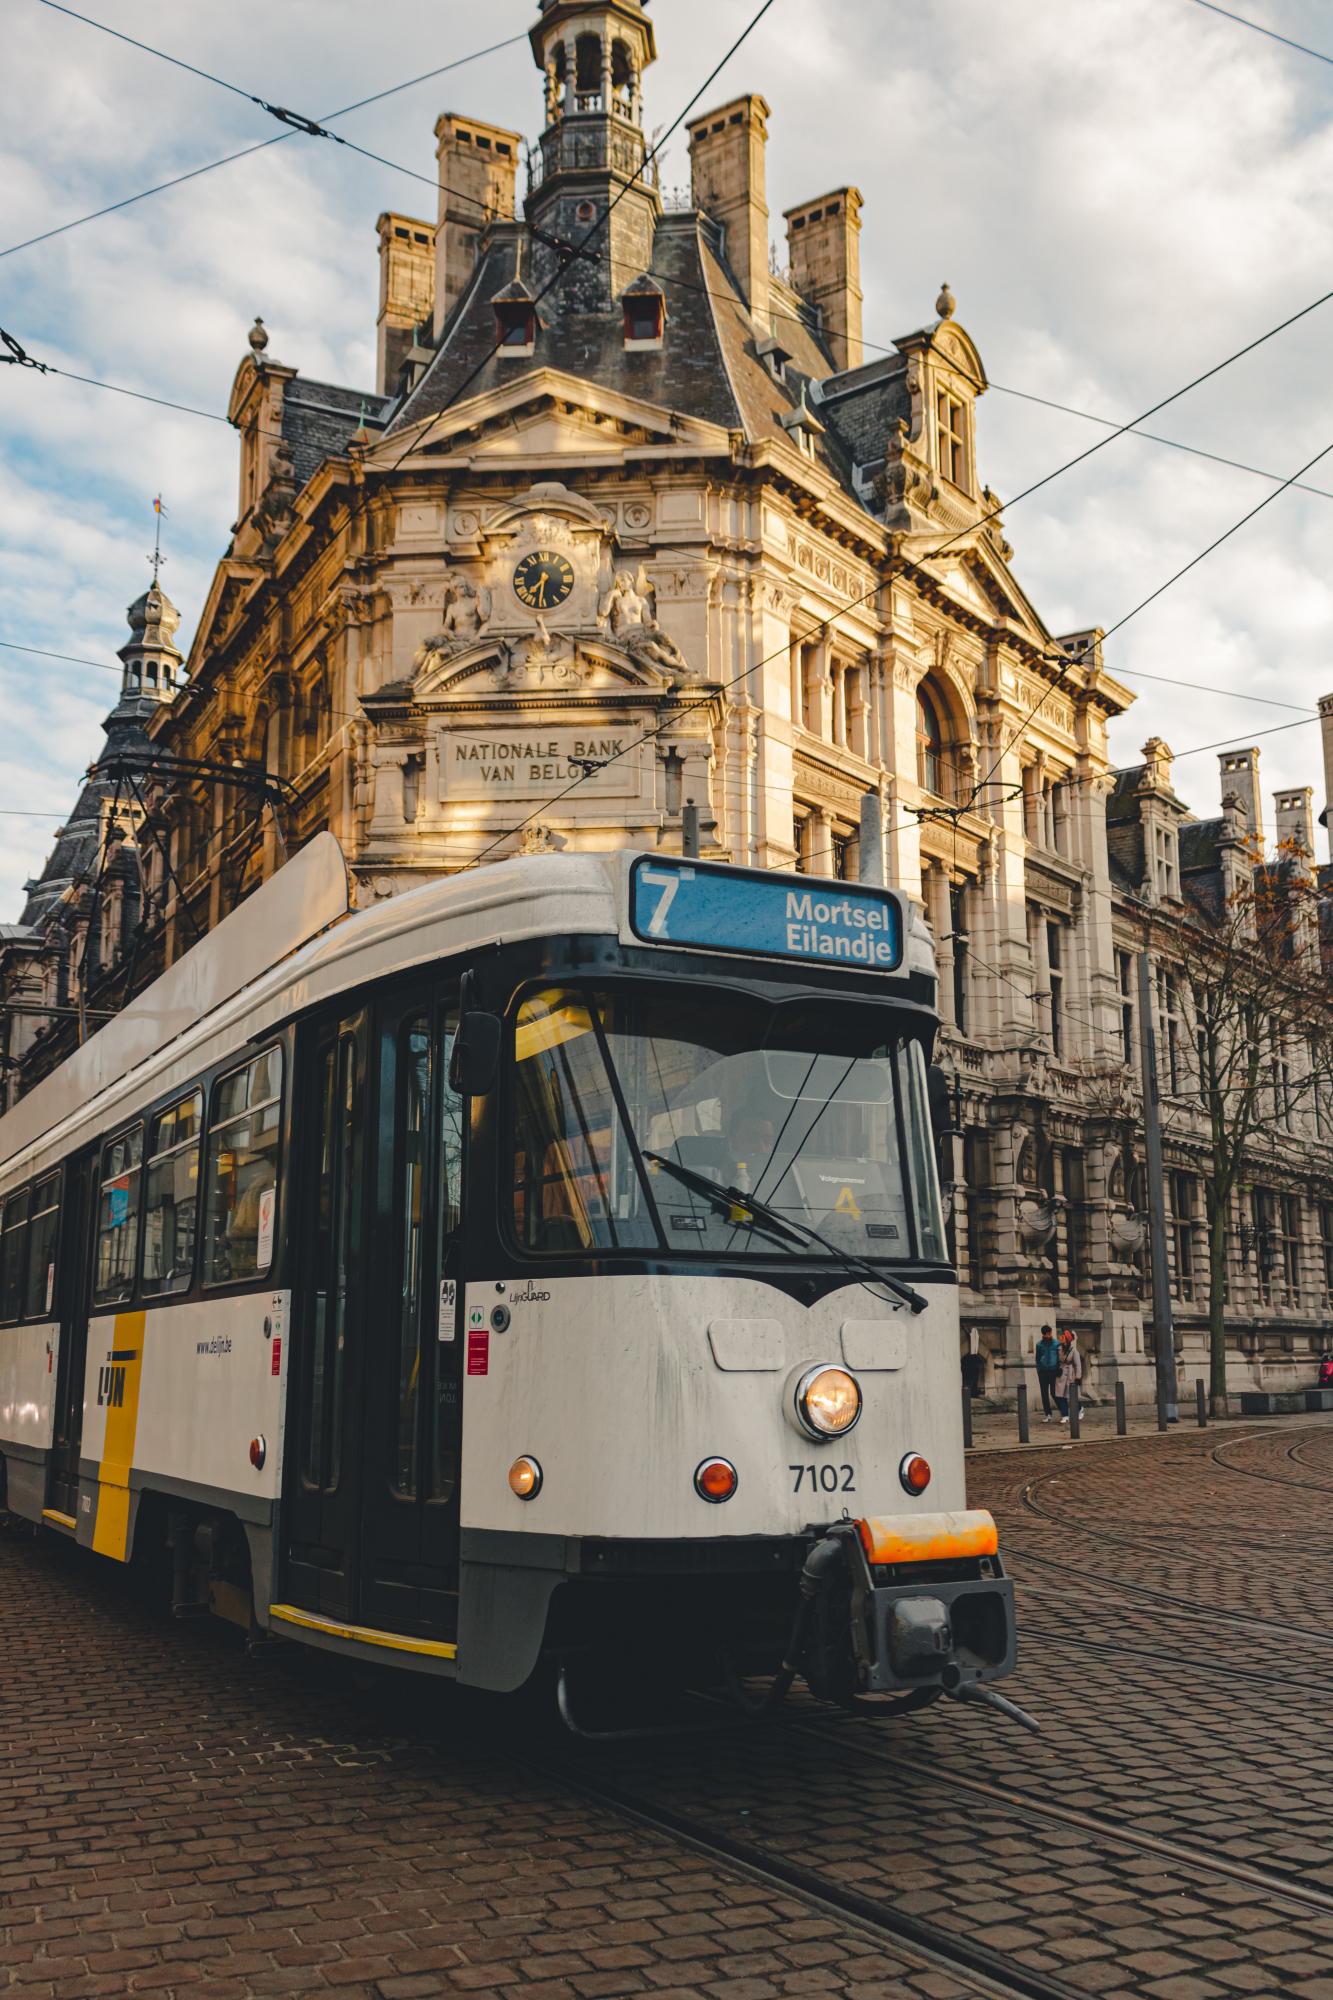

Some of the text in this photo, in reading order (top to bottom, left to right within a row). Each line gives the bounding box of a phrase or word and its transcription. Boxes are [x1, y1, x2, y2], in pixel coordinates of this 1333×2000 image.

[455, 739, 623, 760] NATIONALE BANK
[480, 765, 515, 781] VAN
[641, 872, 679, 934] 7
[785, 892, 889, 931] Mortsel
[786, 923, 892, 965] Eilandje
[789, 1464, 856, 1493] 7102
